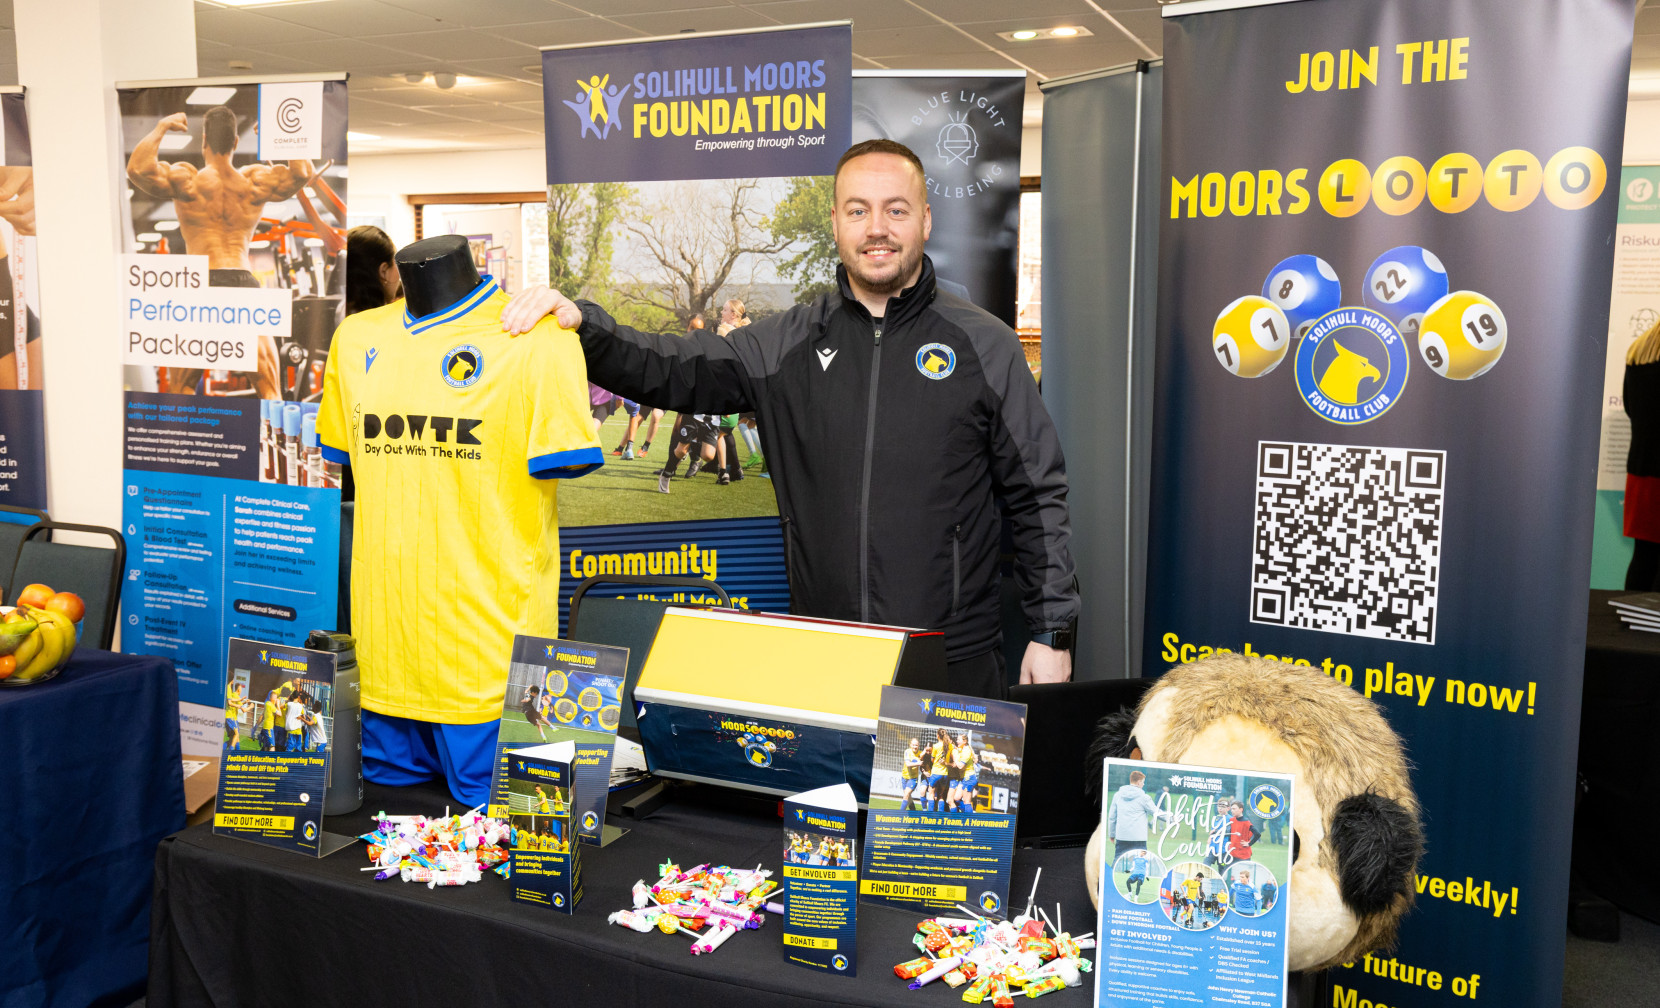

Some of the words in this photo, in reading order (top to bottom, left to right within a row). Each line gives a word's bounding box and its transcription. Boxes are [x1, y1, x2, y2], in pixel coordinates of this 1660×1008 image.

[1285, 46, 1379, 94] JOIN
[1395, 37, 1470, 85] THE
[634, 66, 738, 99] SOLIHULL
[744, 60, 826, 92] MOORS
[634, 92, 826, 138] FOUNDATION
[912, 92, 950, 126] BLUE
[960, 91, 1005, 128] LIGHT
[695, 138, 754, 152] Empowering
[756, 136, 794, 148] through
[798, 134, 825, 147] Sport
[925, 165, 1002, 198] ELLBEING
[1170, 168, 1311, 219] MOORS
[1330, 155, 1597, 209] LOTTO
[129, 265, 201, 291] Sports
[1376, 269, 1407, 301] 22
[1278, 279, 1294, 299] 8
[129, 298, 281, 325] Performance
[1262, 318, 1280, 342] 7
[1309, 312, 1357, 343] SOLIHULL
[1362, 314, 1397, 344] MOORS
[1466, 313, 1498, 344] 19
[129, 331, 245, 363] Packages
[1217, 344, 1233, 367] 7
[1425, 345, 1443, 367] 9
[128, 402, 157, 410] Achieve
[159, 404, 175, 412] your
[198, 406, 242, 416] performance
[1308, 391, 1360, 420] FOOTBALL
[1364, 394, 1390, 416] CLUB
[159, 414, 188, 423] tailored
[190, 416, 220, 426] package
[364, 414, 482, 445] DOWTK
[365, 444, 381, 456] Day
[384, 444, 402, 454] Out
[405, 445, 426, 456] With
[430, 447, 452, 457] The
[456, 449, 481, 460] Kids
[144, 496, 192, 506] Questionnaire
[242, 496, 270, 505] Complete
[272, 499, 292, 508] Clinical
[570, 544, 717, 581] Community
[239, 603, 267, 613] Additional
[268, 608, 290, 617] Services
[270, 658, 307, 671] FOUNDATION
[556, 653, 596, 665] FOUNDATION
[1364, 662, 1435, 707] play
[1445, 676, 1537, 716] now!
[936, 700, 964, 711] SOLIHULL
[965, 705, 987, 713] MOORS
[936, 707, 986, 723] FOUNDATION
[721, 721, 750, 732] MOORS
[276, 757, 308, 765] Empowering
[309, 757, 324, 766] Young
[578, 749, 608, 758] supporting
[527, 767, 560, 778] FOUNDATION
[1183, 781, 1222, 790] FOUNDATION
[223, 816, 238, 825] FIND
[240, 817, 253, 825] OUT
[255, 818, 273, 826] MORE
[807, 817, 846, 829] FOUNDATION
[875, 815, 901, 823] Women:
[903, 816, 919, 824] More
[920, 817, 936, 825] Than
[943, 818, 963, 826] Team,
[971, 819, 1009, 828] Movement!
[1152, 792, 1234, 838] Ability
[1158, 833, 1241, 864] Counts
[790, 868, 801, 877] GET
[803, 869, 836, 879] INVOLVED
[871, 883, 890, 893] FIND
[893, 885, 910, 895] OUT
[913, 886, 937, 896] MORE
[1127, 931, 1172, 941] INVOLVED?
[1239, 928, 1259, 936] JOIN
[790, 937, 815, 946] DONATE
[1363, 951, 1442, 990] future
[1452, 973, 1480, 999] of
